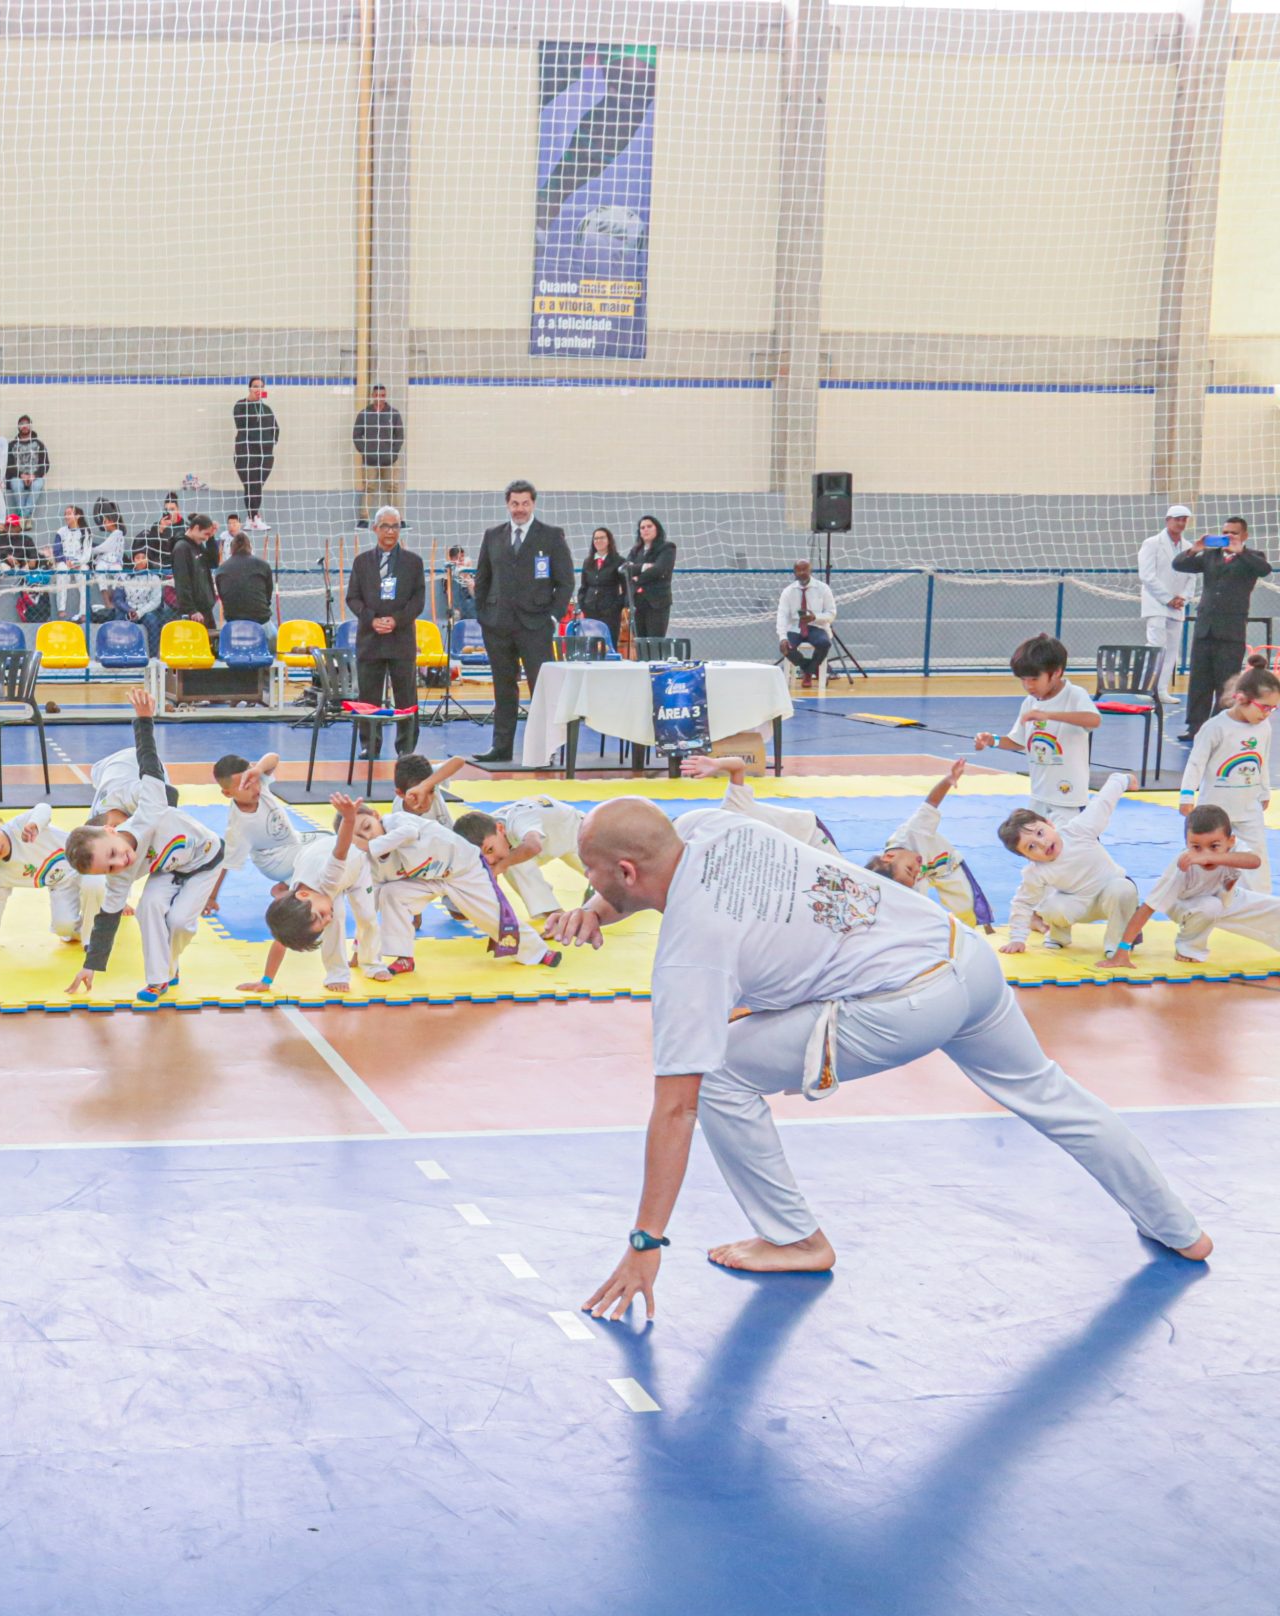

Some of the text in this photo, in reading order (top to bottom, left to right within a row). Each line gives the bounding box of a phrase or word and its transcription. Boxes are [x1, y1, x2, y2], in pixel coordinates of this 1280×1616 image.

[539, 279, 578, 294] Quanto
[580, 282, 607, 294] mais
[549, 301, 556, 310] a
[599, 301, 631, 312] maior
[538, 315, 613, 331] é a felicidade
[537, 334, 596, 349] de ganhar!
[657, 705, 701, 720] ÁREA 3
